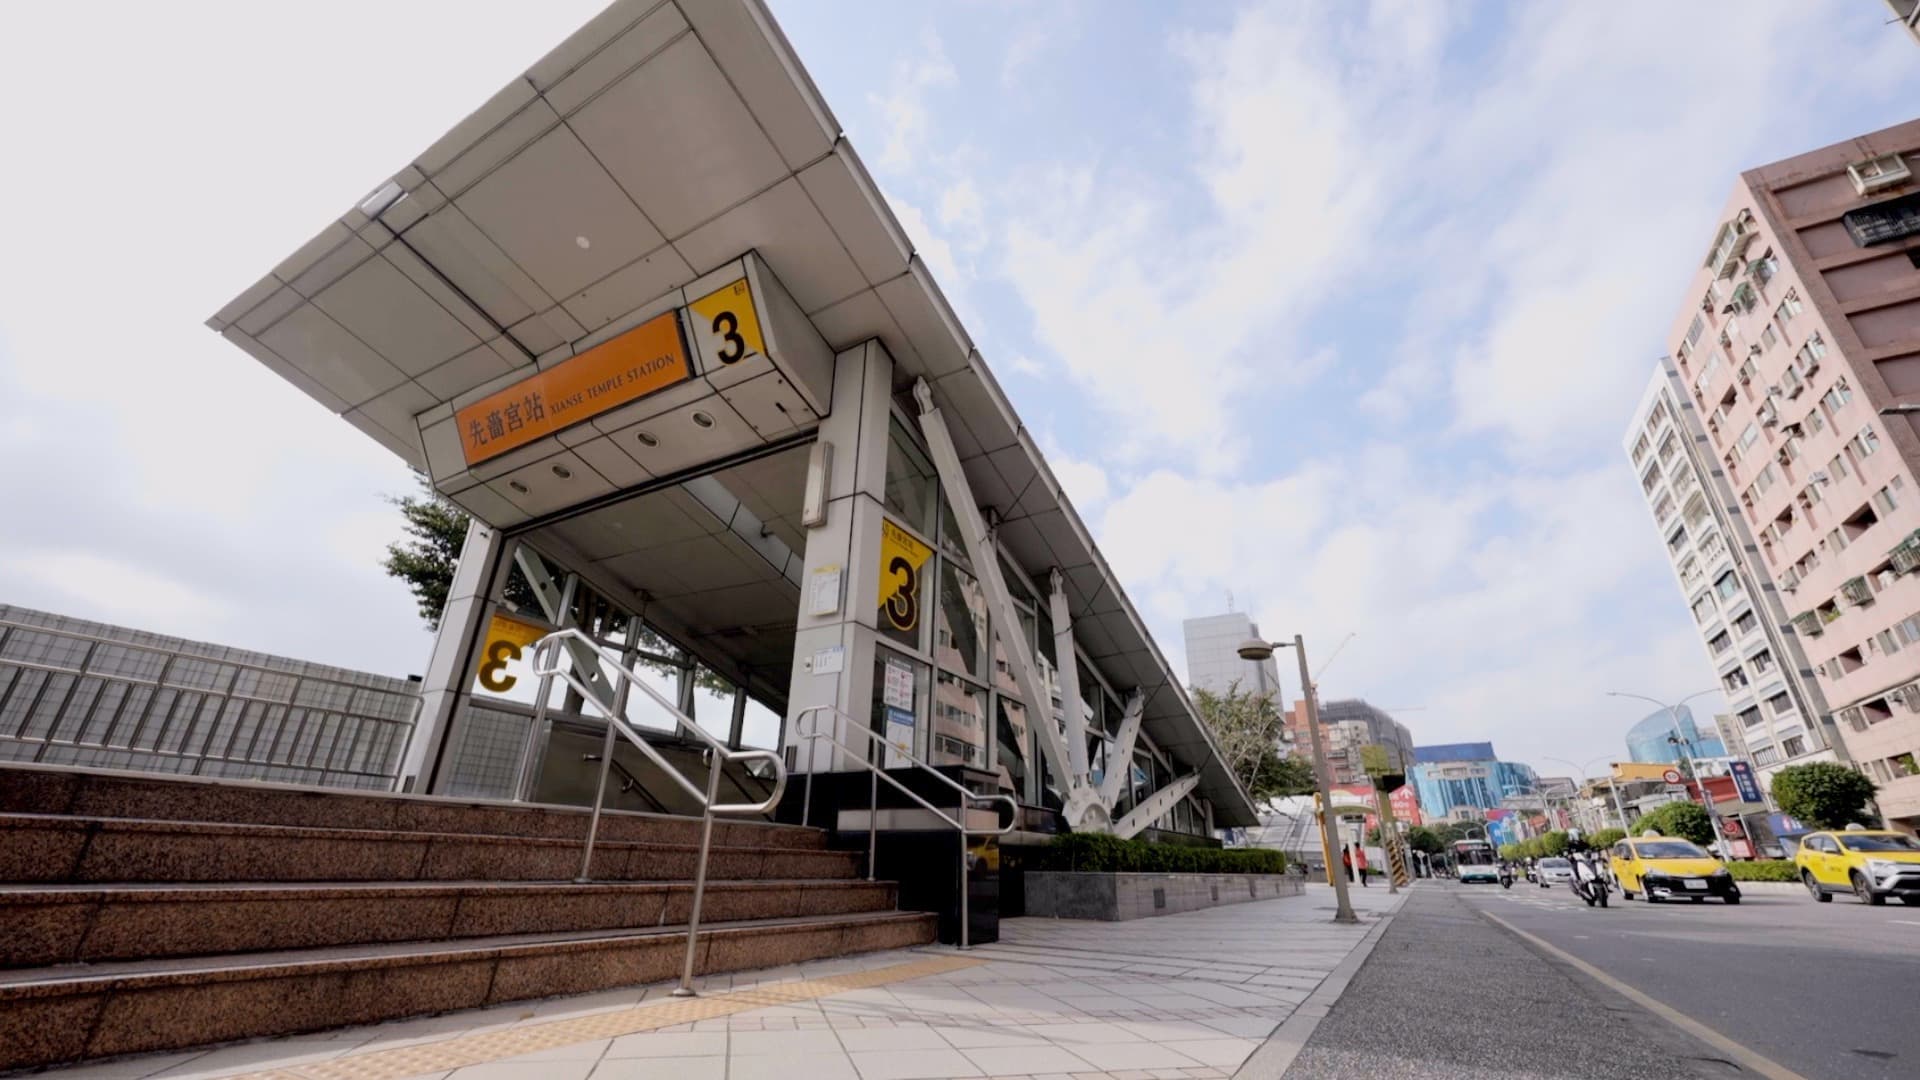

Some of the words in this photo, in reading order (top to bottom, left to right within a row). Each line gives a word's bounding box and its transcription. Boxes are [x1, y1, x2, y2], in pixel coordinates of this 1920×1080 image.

[712, 311, 745, 365] 3
[550, 392, 583, 416] XIANSE
[587, 374, 623, 399] TEMPLE
[627, 353, 675, 382] STATION
[469, 391, 545, 449] 先嗇宮站
[886, 556, 916, 631] 3
